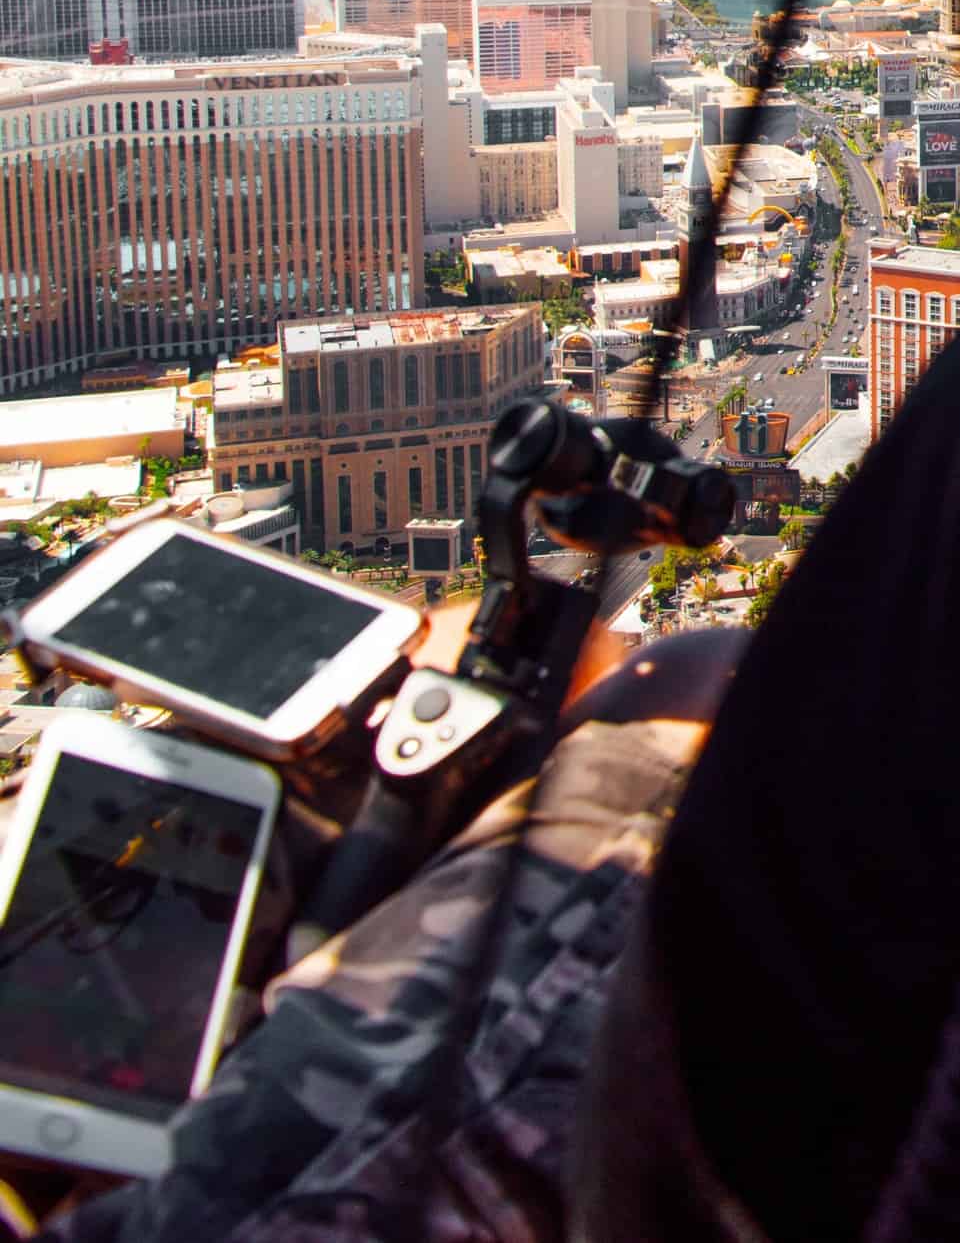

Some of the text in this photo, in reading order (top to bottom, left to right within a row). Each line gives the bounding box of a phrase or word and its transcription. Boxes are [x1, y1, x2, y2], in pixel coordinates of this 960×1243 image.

[213, 72, 339, 90] VENETIAN
[928, 102, 960, 111] MIRAGE
[925, 141, 958, 152] LOVE
